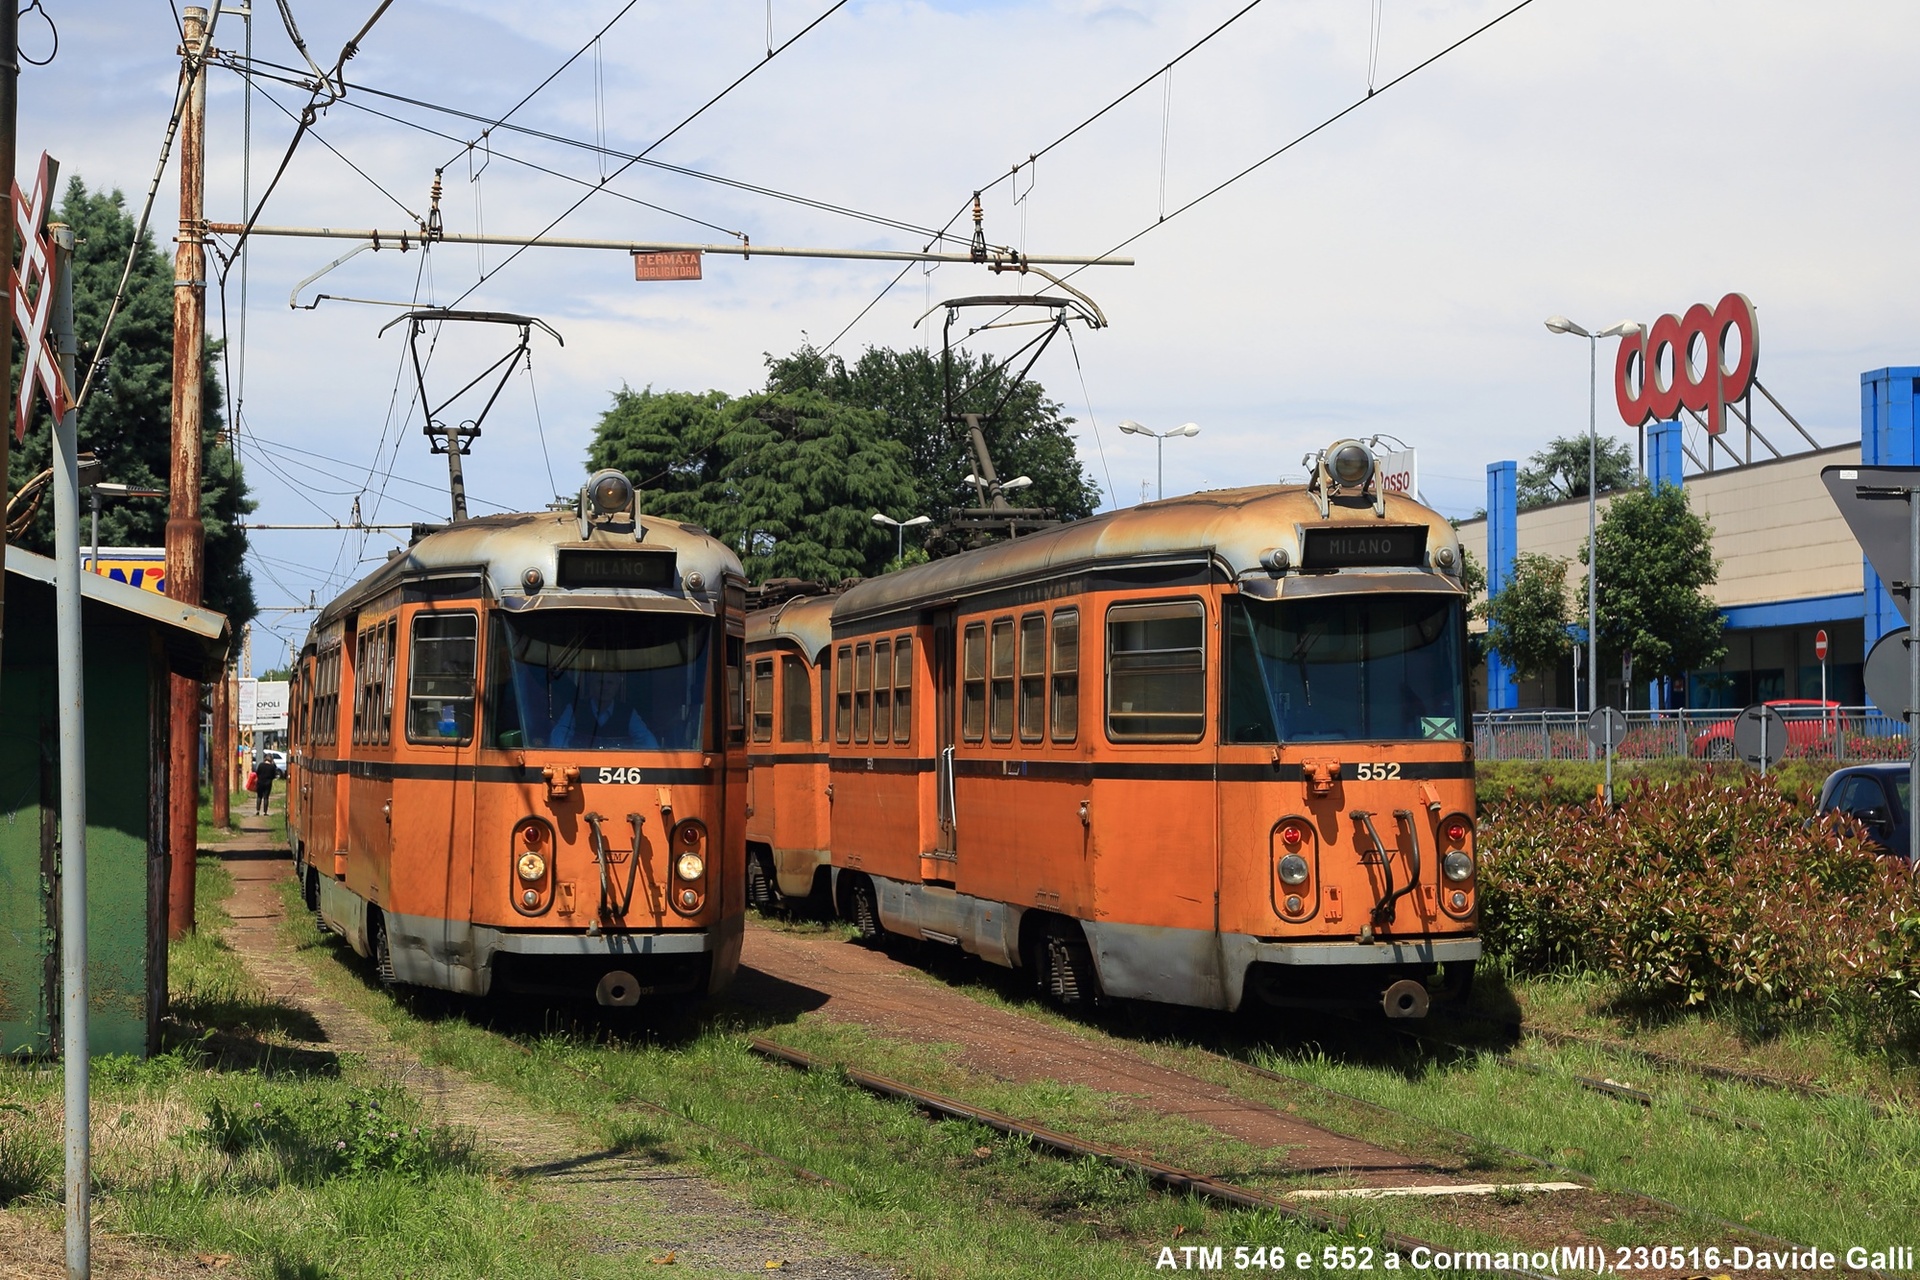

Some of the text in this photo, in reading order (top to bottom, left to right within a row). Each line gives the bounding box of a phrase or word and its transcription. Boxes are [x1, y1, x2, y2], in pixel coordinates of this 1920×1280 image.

[637, 254, 699, 265] FERMATA
[637, 266, 701, 278] OBBLIGATORIA
[1615, 292, 1759, 436] coop
[1328, 539, 1392, 555] MILANO
[583, 560, 645, 576] MILANO
[598, 767, 641, 785] 546
[1357, 762, 1401, 781] 552
